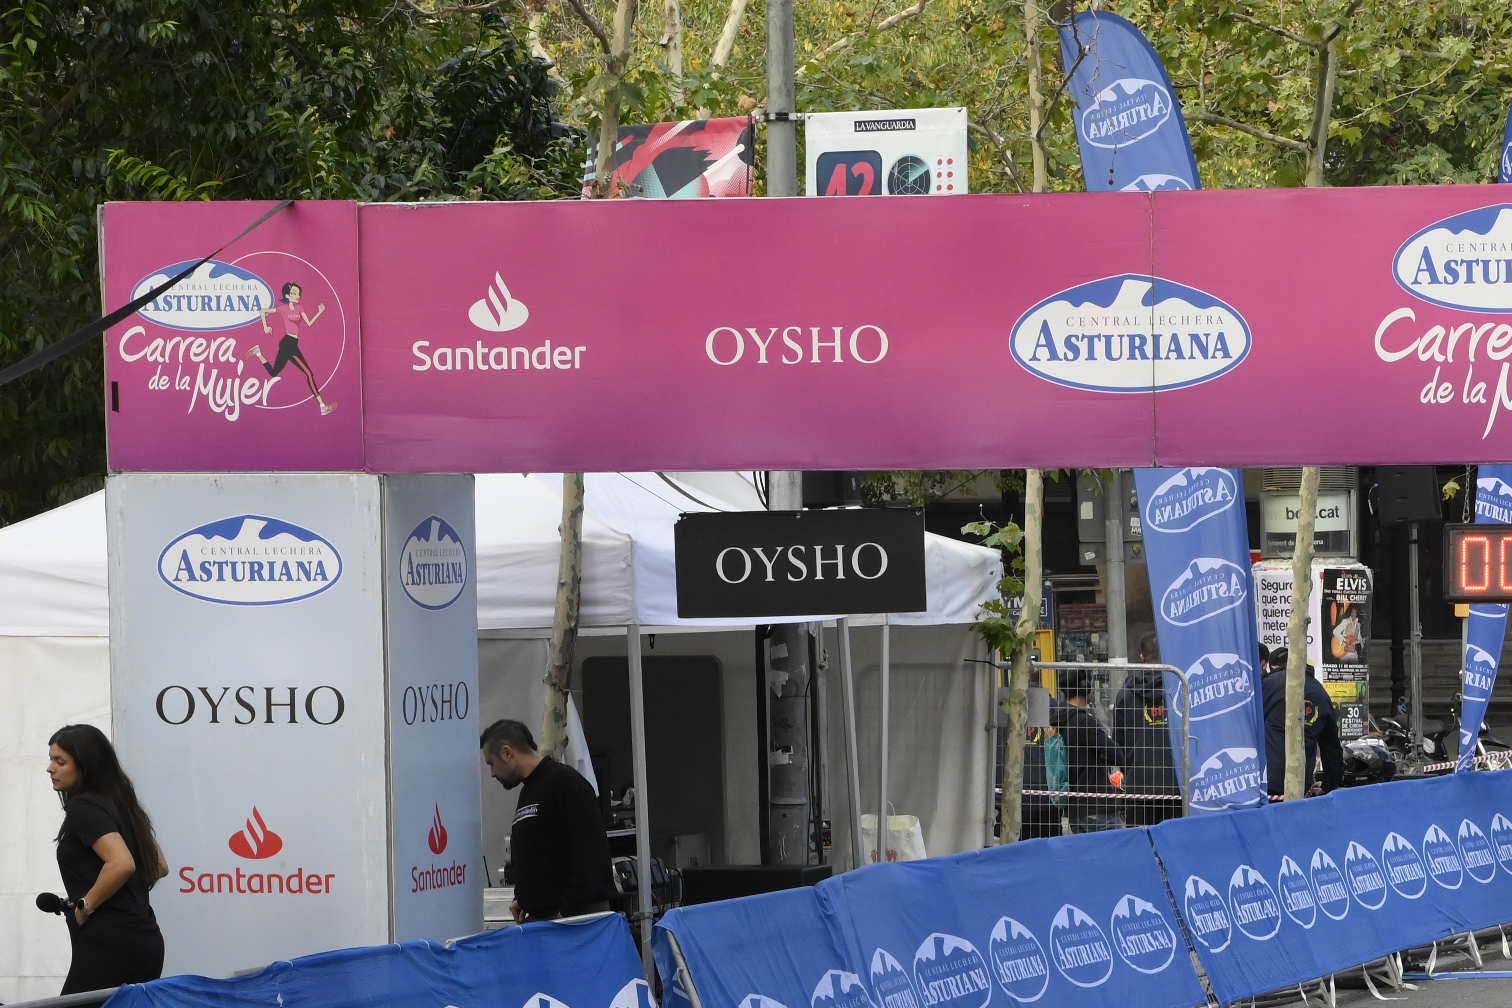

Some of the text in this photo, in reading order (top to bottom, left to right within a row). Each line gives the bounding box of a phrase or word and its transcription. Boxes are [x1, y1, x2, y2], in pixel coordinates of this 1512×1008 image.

[866, 119, 915, 130] VANGUARDIA
[168, 283, 209, 291] ENTRAL
[1066, 315, 1225, 327] CENTRAL LECHERA
[119, 326, 237, 363] Carrera
[412, 340, 586, 371] Santander
[705, 325, 889, 366] OYSHO
[1028, 319, 1232, 362] ASTURIANA
[148, 360, 282, 422] de la Mujer
[1419, 365, 1454, 404] de
[1462, 364, 1488, 404] la
[173, 549, 329, 583] ASTURIANA
[201, 546, 323, 556] CENTRAL LECHERA
[716, 543, 888, 584] OYSHO
[405, 553, 463, 586] ASTURIANA
[1337, 578, 1367, 590] ELVIS
[1261, 595, 1278, 605] que
[1262, 605, 1294, 618] quiere
[1263, 635, 1281, 644] este
[155, 685, 345, 725] OYSHO
[402, 681, 468, 725] OYSHO
[1347, 707, 1360, 718] 30
[179, 866, 336, 894] Santander
[411, 859, 466, 893] Santander
[995, 951, 1046, 984] ASTURIANA
[1056, 938, 1110, 969] ASTURIANA
[918, 968, 989, 1006] ASTURIANA
